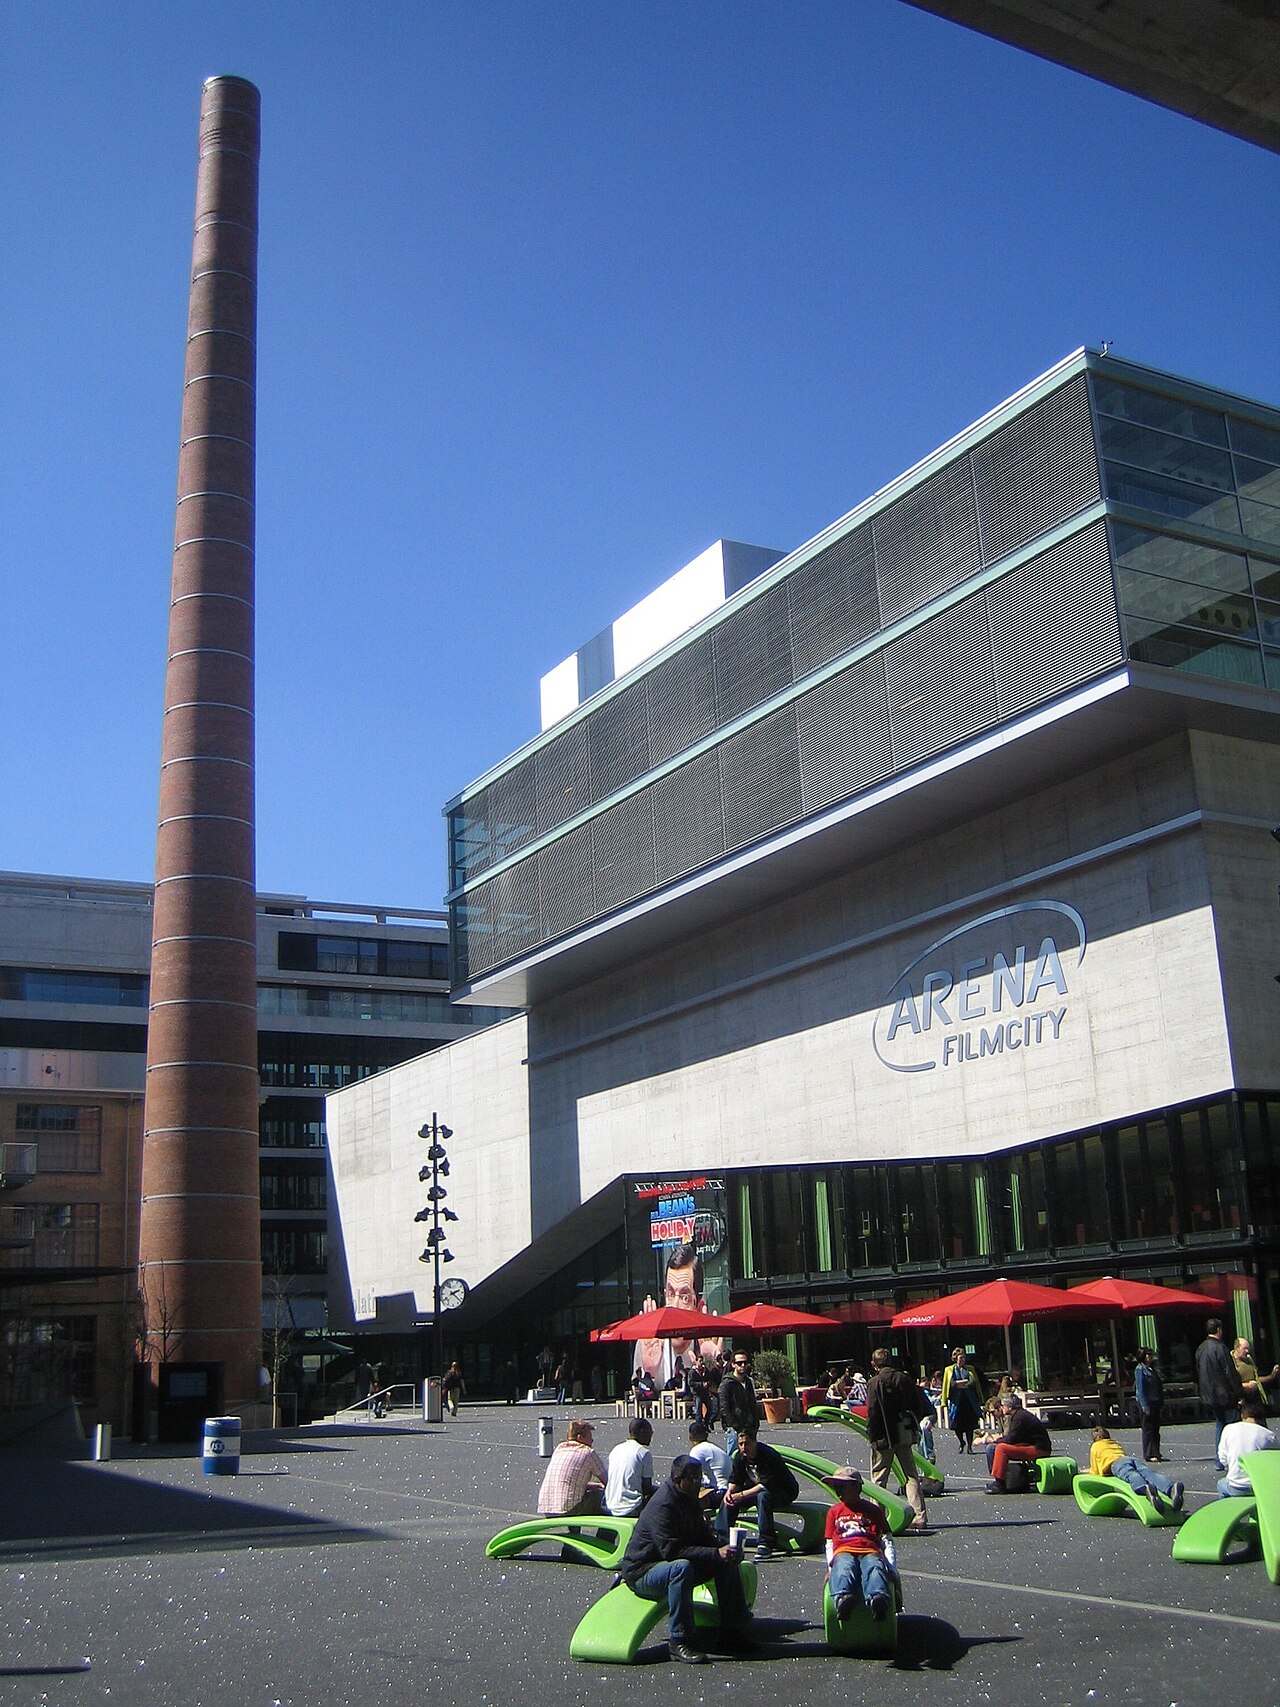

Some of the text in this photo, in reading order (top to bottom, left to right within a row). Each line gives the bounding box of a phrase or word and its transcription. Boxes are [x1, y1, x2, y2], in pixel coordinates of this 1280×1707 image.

[887, 936, 1068, 1041] ARENA
[943, 1007, 1067, 1066] FILMCITY
[651, 1217, 695, 1244] HOLIDAY
